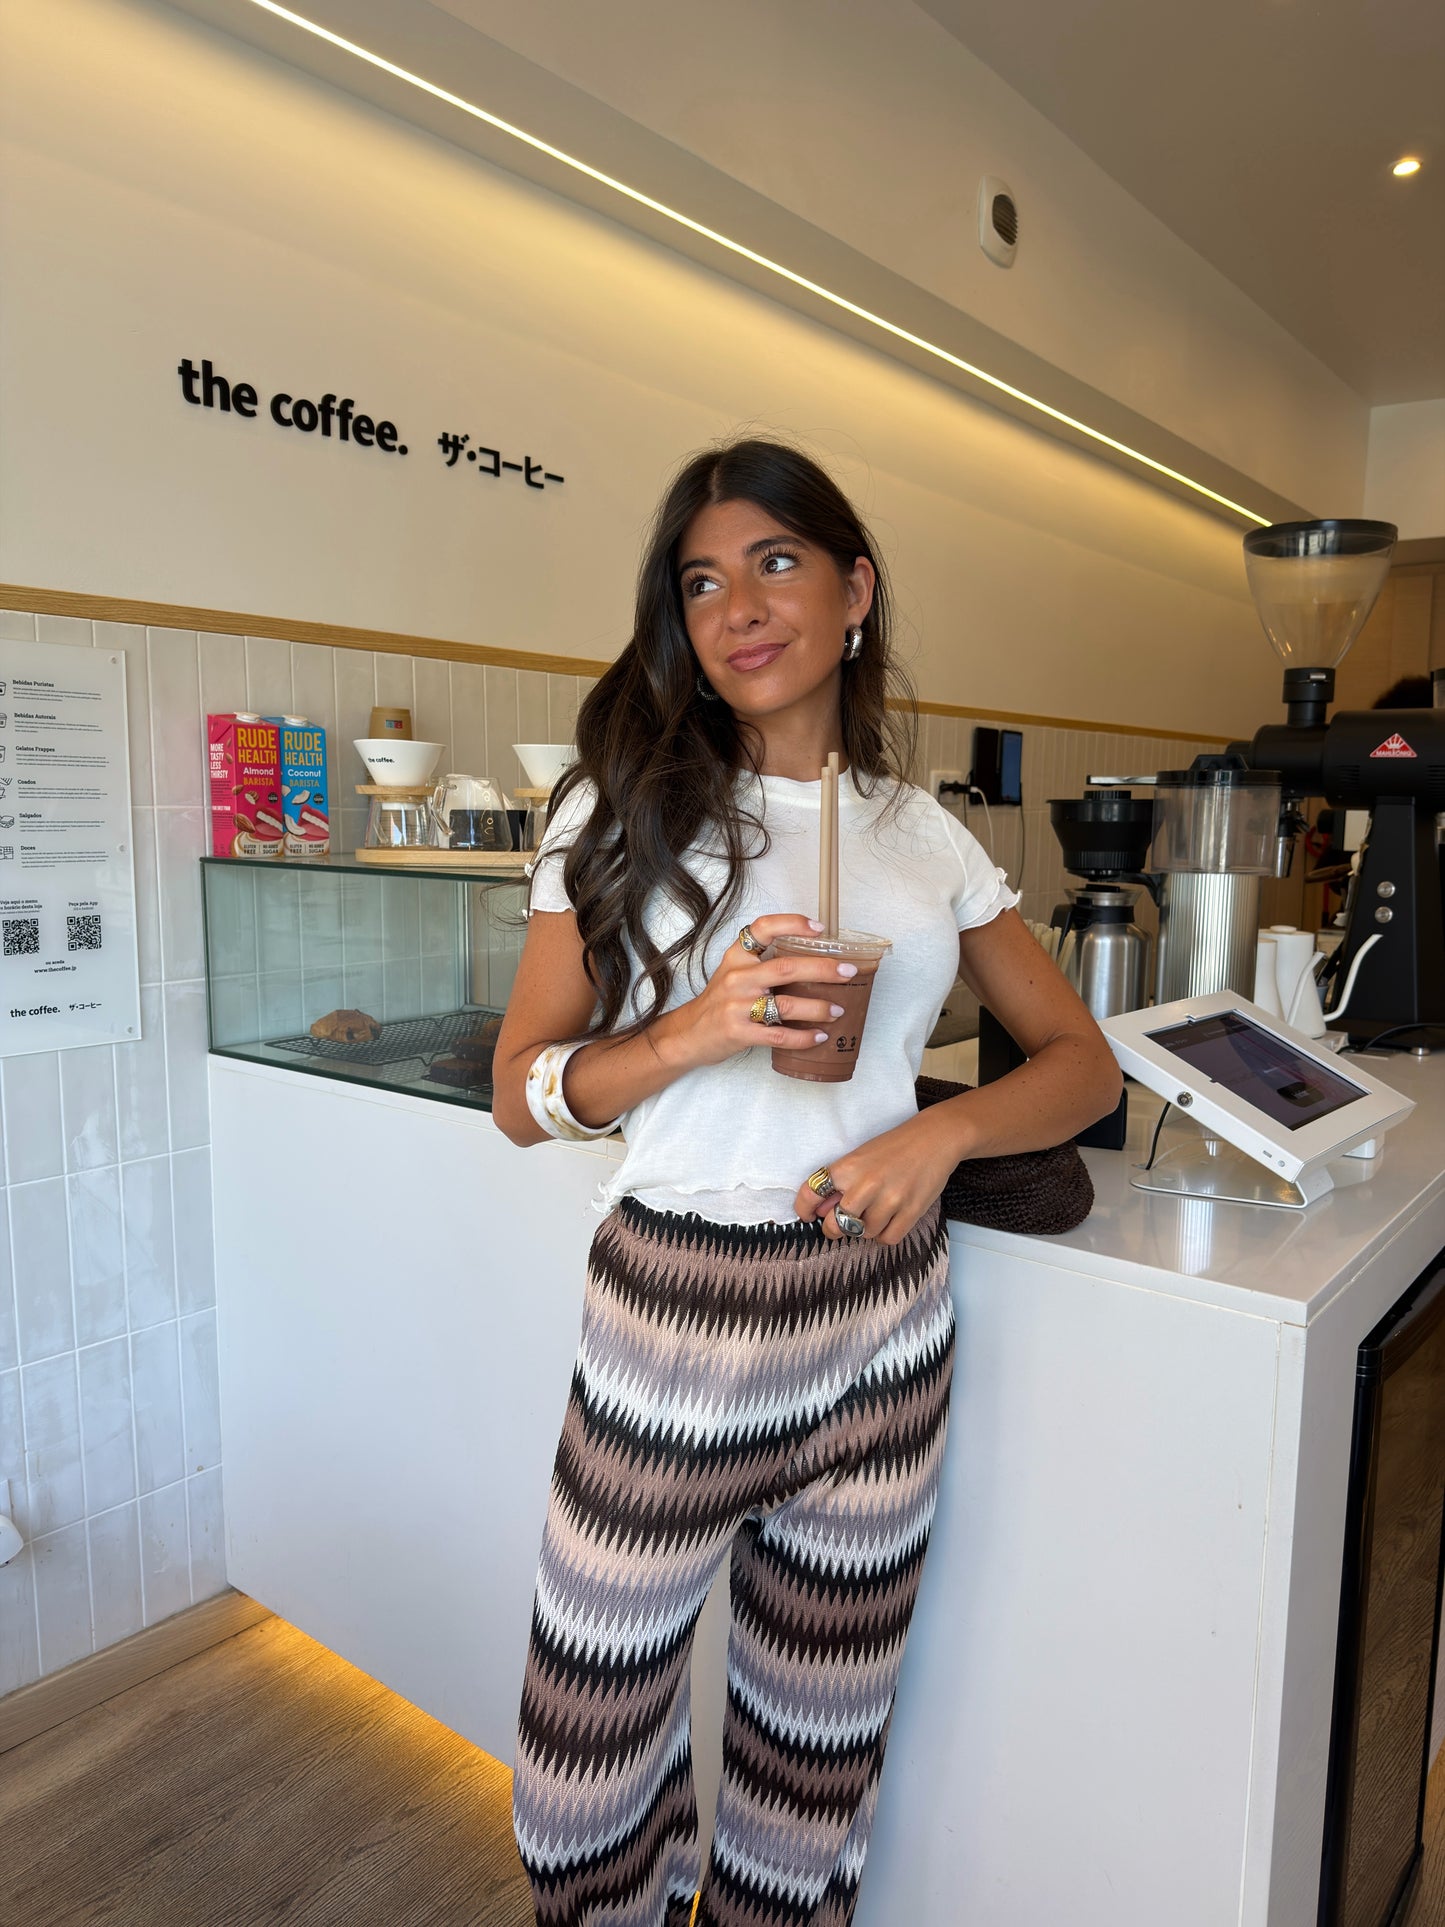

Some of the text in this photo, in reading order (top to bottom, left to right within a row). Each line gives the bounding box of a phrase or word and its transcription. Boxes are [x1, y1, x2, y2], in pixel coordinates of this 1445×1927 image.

[178, 359, 409, 455] the coffee.
[438, 432, 565, 489] ザ・コーヒー
[237, 728, 276, 749] RUDE
[284, 731, 322, 751] RUDE
[210, 743, 224, 751] MORE
[210, 752, 225, 761] TASTY
[238, 749, 277, 765] HEALTH
[284, 752, 323, 767] HEALTH
[210, 761, 222, 770] LESS
[210, 770, 228, 778] THIRSTY
[243, 767, 274, 776] Almond
[287, 768, 321, 778] Coconut
[243, 777, 275, 786] BARISTA
[290, 779, 320, 787] BARISTA
[10, 1005, 60, 1018] the coffee.
